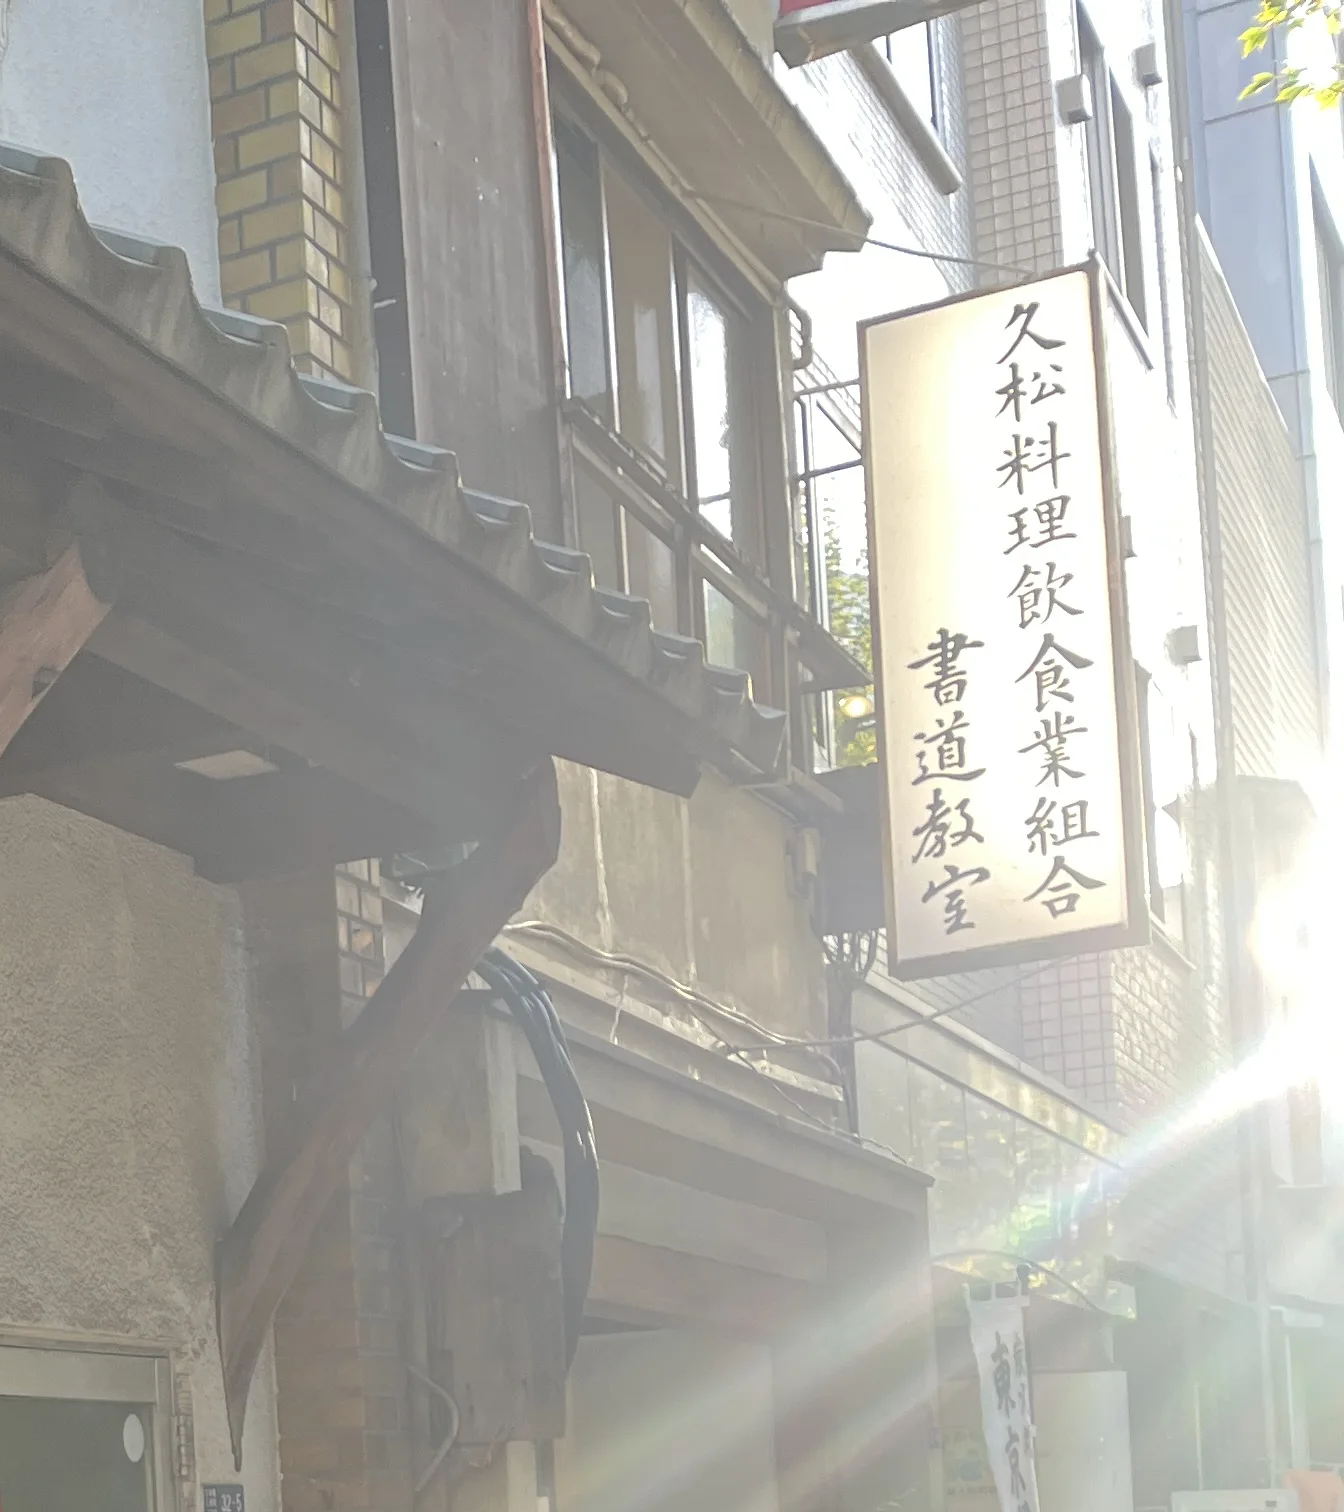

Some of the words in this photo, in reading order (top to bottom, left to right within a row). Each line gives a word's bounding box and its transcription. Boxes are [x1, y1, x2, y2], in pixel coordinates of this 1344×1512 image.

[906, 627, 990, 932] 書道教室
[994, 302, 1106, 919] 久松料理飲食業組合
